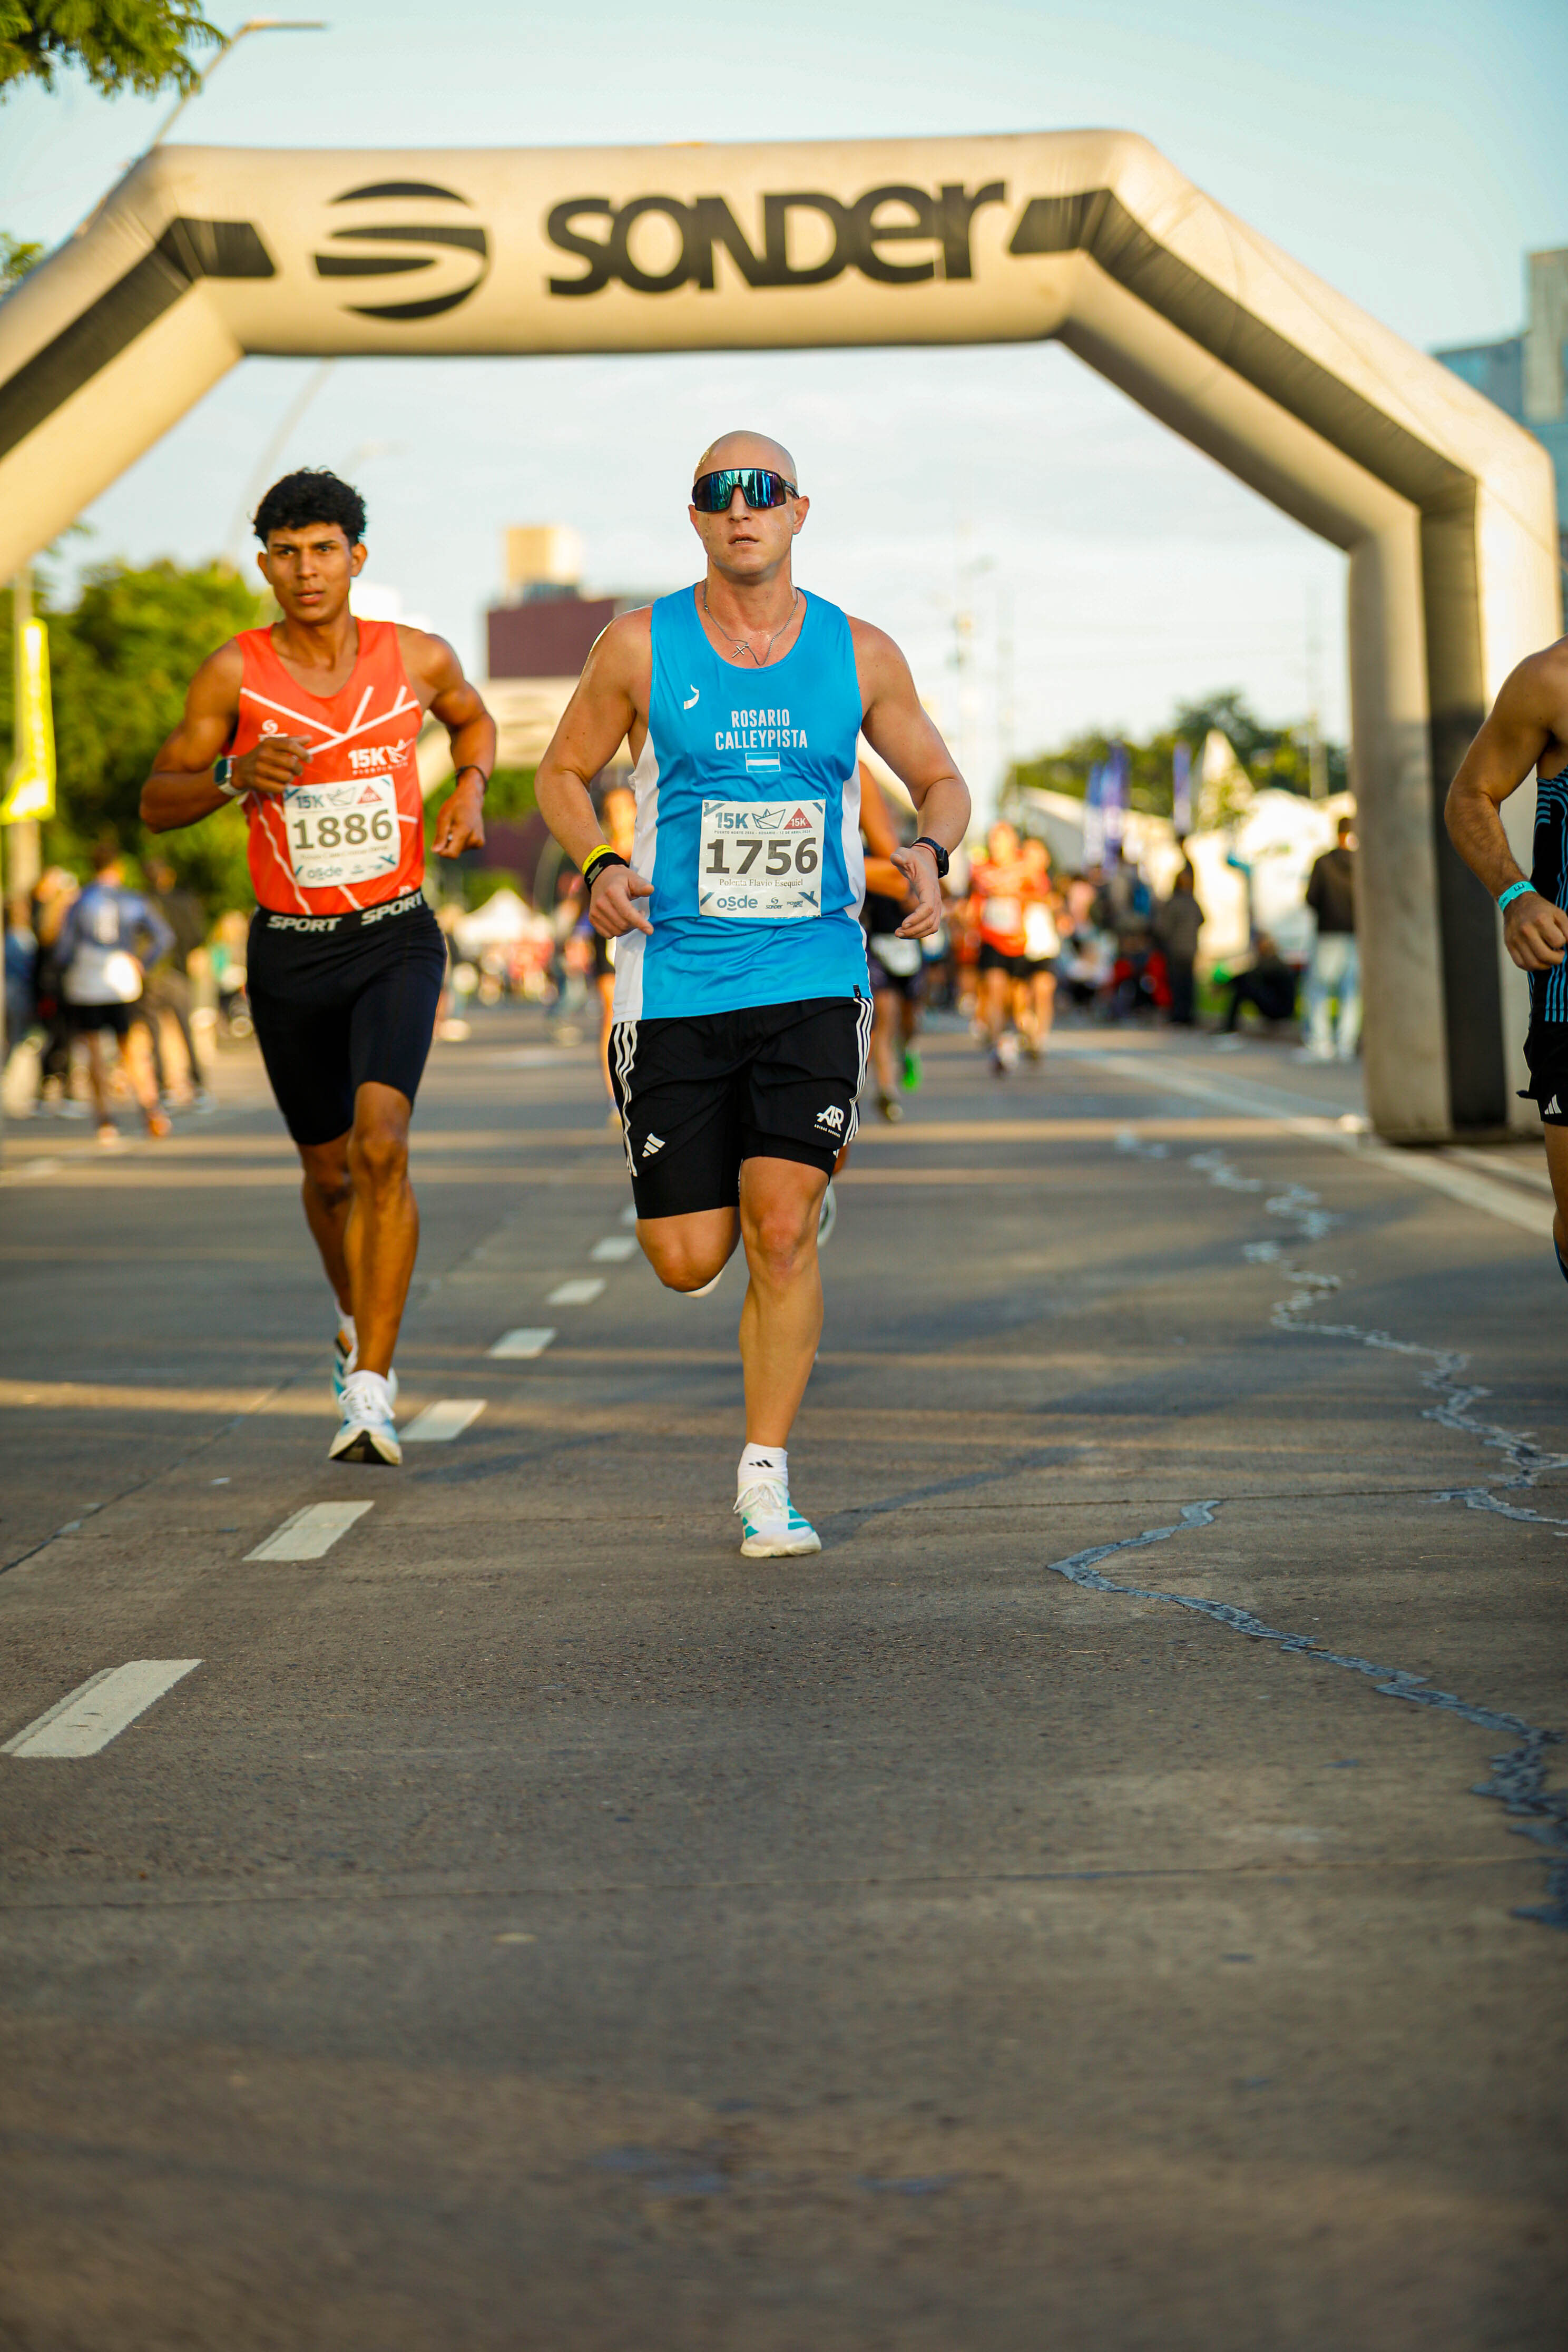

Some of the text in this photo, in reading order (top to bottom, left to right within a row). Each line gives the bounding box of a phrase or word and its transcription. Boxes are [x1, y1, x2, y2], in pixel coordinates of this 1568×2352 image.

[731, 709, 790, 728] ROSARIO
[715, 729, 808, 751] CALLEYPISTA
[347, 746, 388, 769] 15K
[296, 793, 325, 809] 15K
[293, 808, 393, 849] 1886
[715, 812, 749, 829] 15K
[790, 817, 807, 827] 15K
[706, 837, 818, 876] 1756
[719, 878, 803, 888] Polenta Flavio Esequiel
[266, 890, 422, 933] SPORT SPORT
[717, 894, 758, 911] osde
